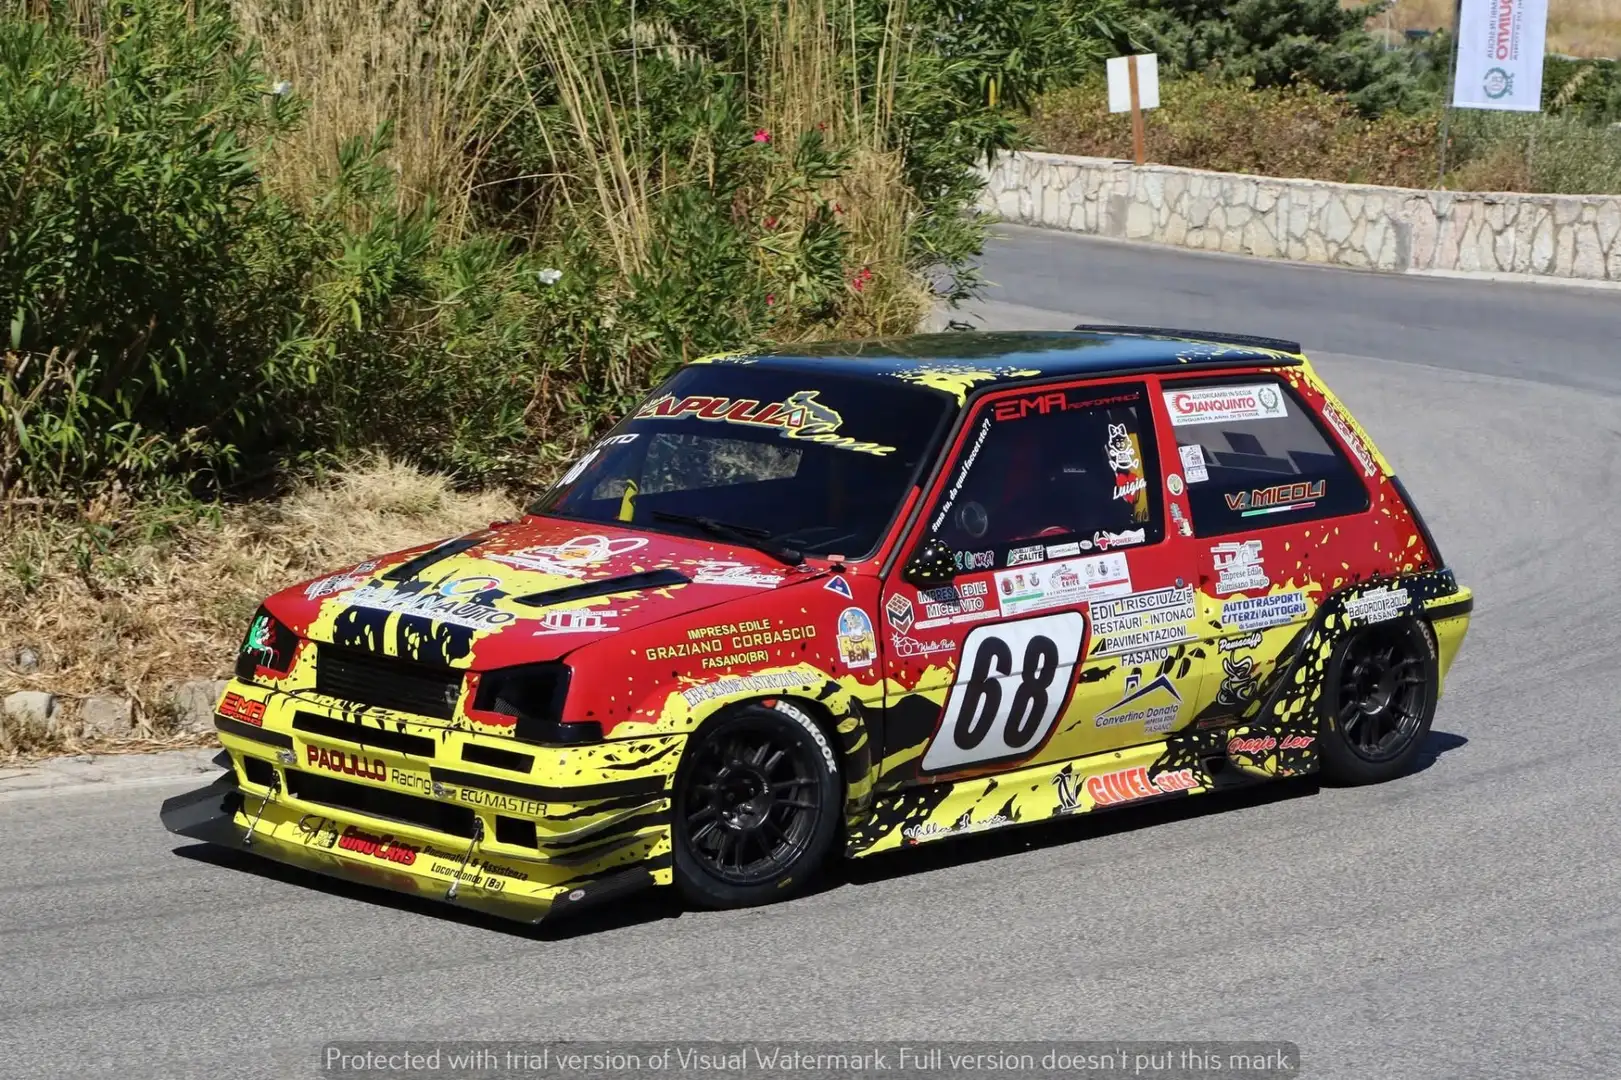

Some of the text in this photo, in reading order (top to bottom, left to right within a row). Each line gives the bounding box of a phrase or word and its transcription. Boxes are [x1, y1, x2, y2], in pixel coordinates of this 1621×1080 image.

[634, 396, 808, 428] APULIA
[995, 393, 1067, 421] EMA
[1174, 393, 1256, 415] GIANQUINTO
[1112, 477, 1148, 500] Luigia
[1250, 479, 1326, 507] MICOLI
[1017, 552, 1044, 561] SALITE
[917, 581, 988, 604] IMPRESA EDILE
[1223, 592, 1303, 612] AUTOTRASPORTI
[960, 598, 985, 613] VITO
[1368, 608, 1398, 623] FASANO
[687, 618, 771, 640] IMPRESA EDILE
[1093, 617, 1142, 635] RESTAURI
[1150, 607, 1195, 625] INTONACI
[645, 625, 817, 661] GRAZIANO CORBASCIO
[1106, 625, 1187, 649] PAVIMENTAZIONI
[702, 650, 769, 669] FASANO(BR)
[1121, 647, 1168, 667] FASANO
[953, 633, 1063, 751] 68
[221, 691, 267, 719] EMA
[1095, 703, 1179, 728] Convertino Donato
[1280, 734, 1316, 750] Leo
[392, 768, 432, 796] Racing
[1086, 767, 1158, 806] GIVEL
